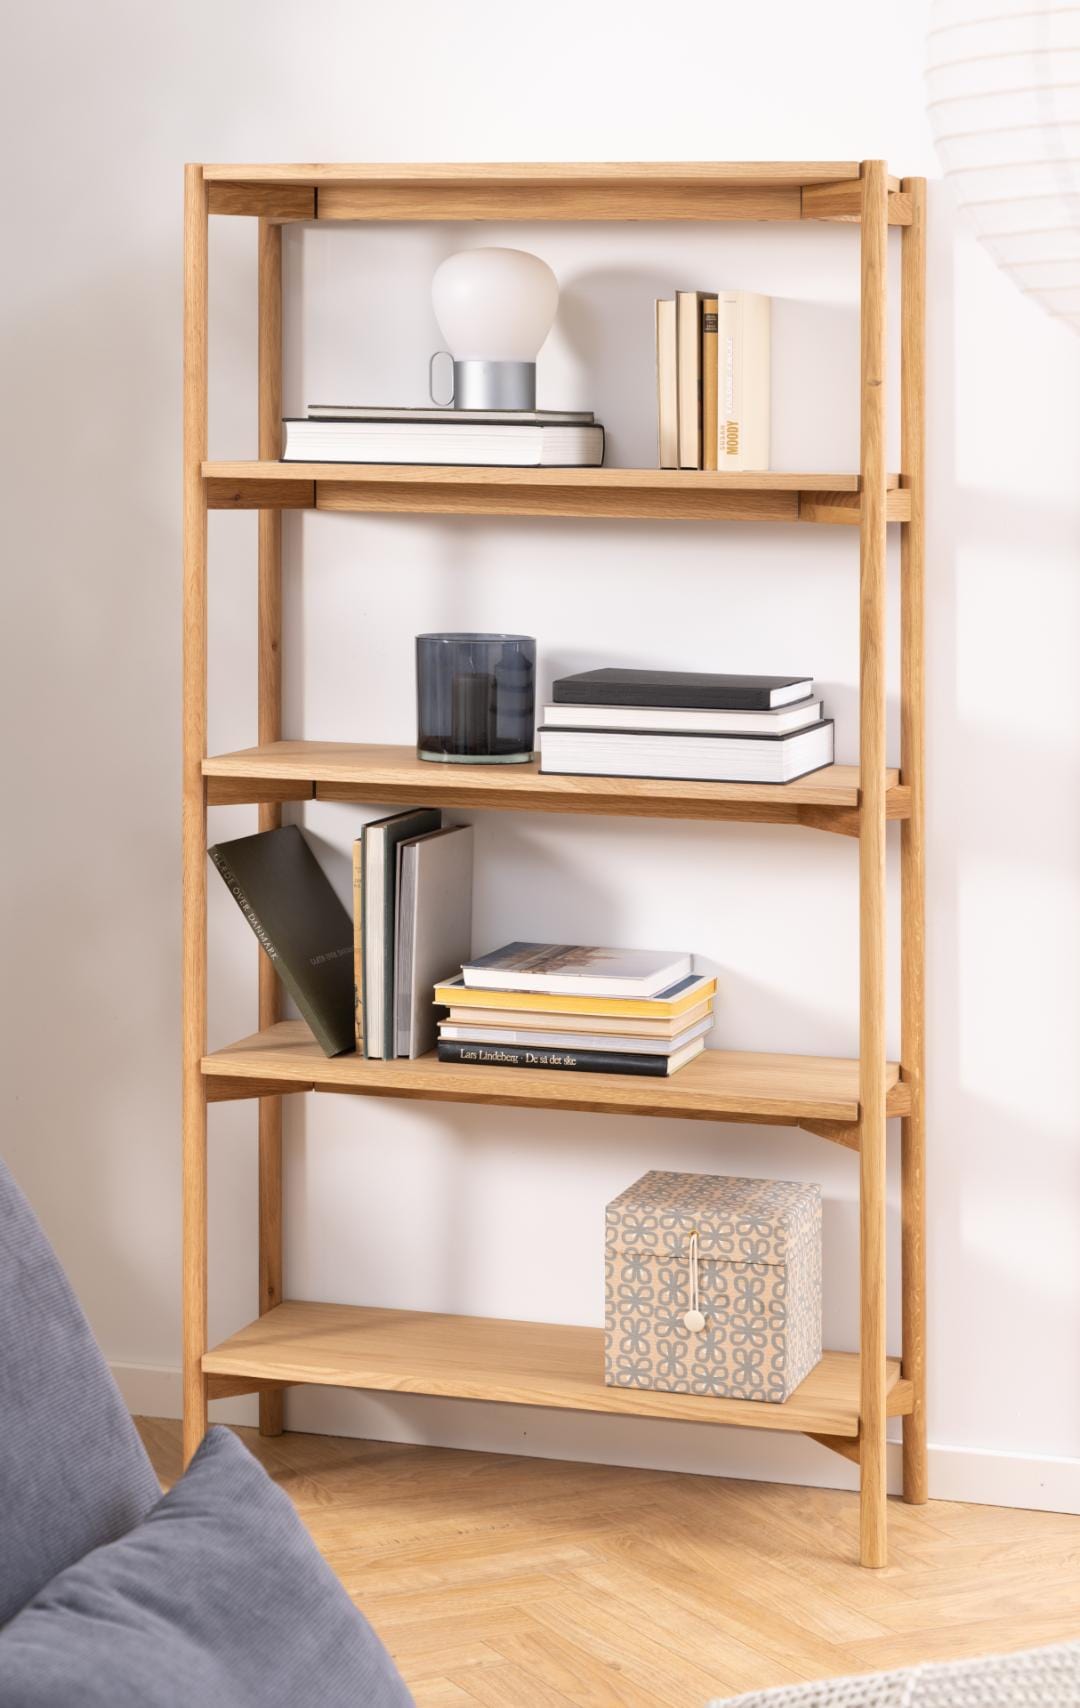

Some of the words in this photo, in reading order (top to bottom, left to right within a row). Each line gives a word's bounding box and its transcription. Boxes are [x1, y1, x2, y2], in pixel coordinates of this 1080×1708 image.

[726, 420, 739, 456] MOODY
[232, 886, 251, 912] OVER
[247, 912, 279, 961] DANMARK
[460, 1048, 478, 1060] Lars
[479, 1049, 519, 1064] Lindeberg
[525, 1052, 538, 1064] De
[549, 1054, 562, 1065] det
[563, 1055, 577, 1066] ske
